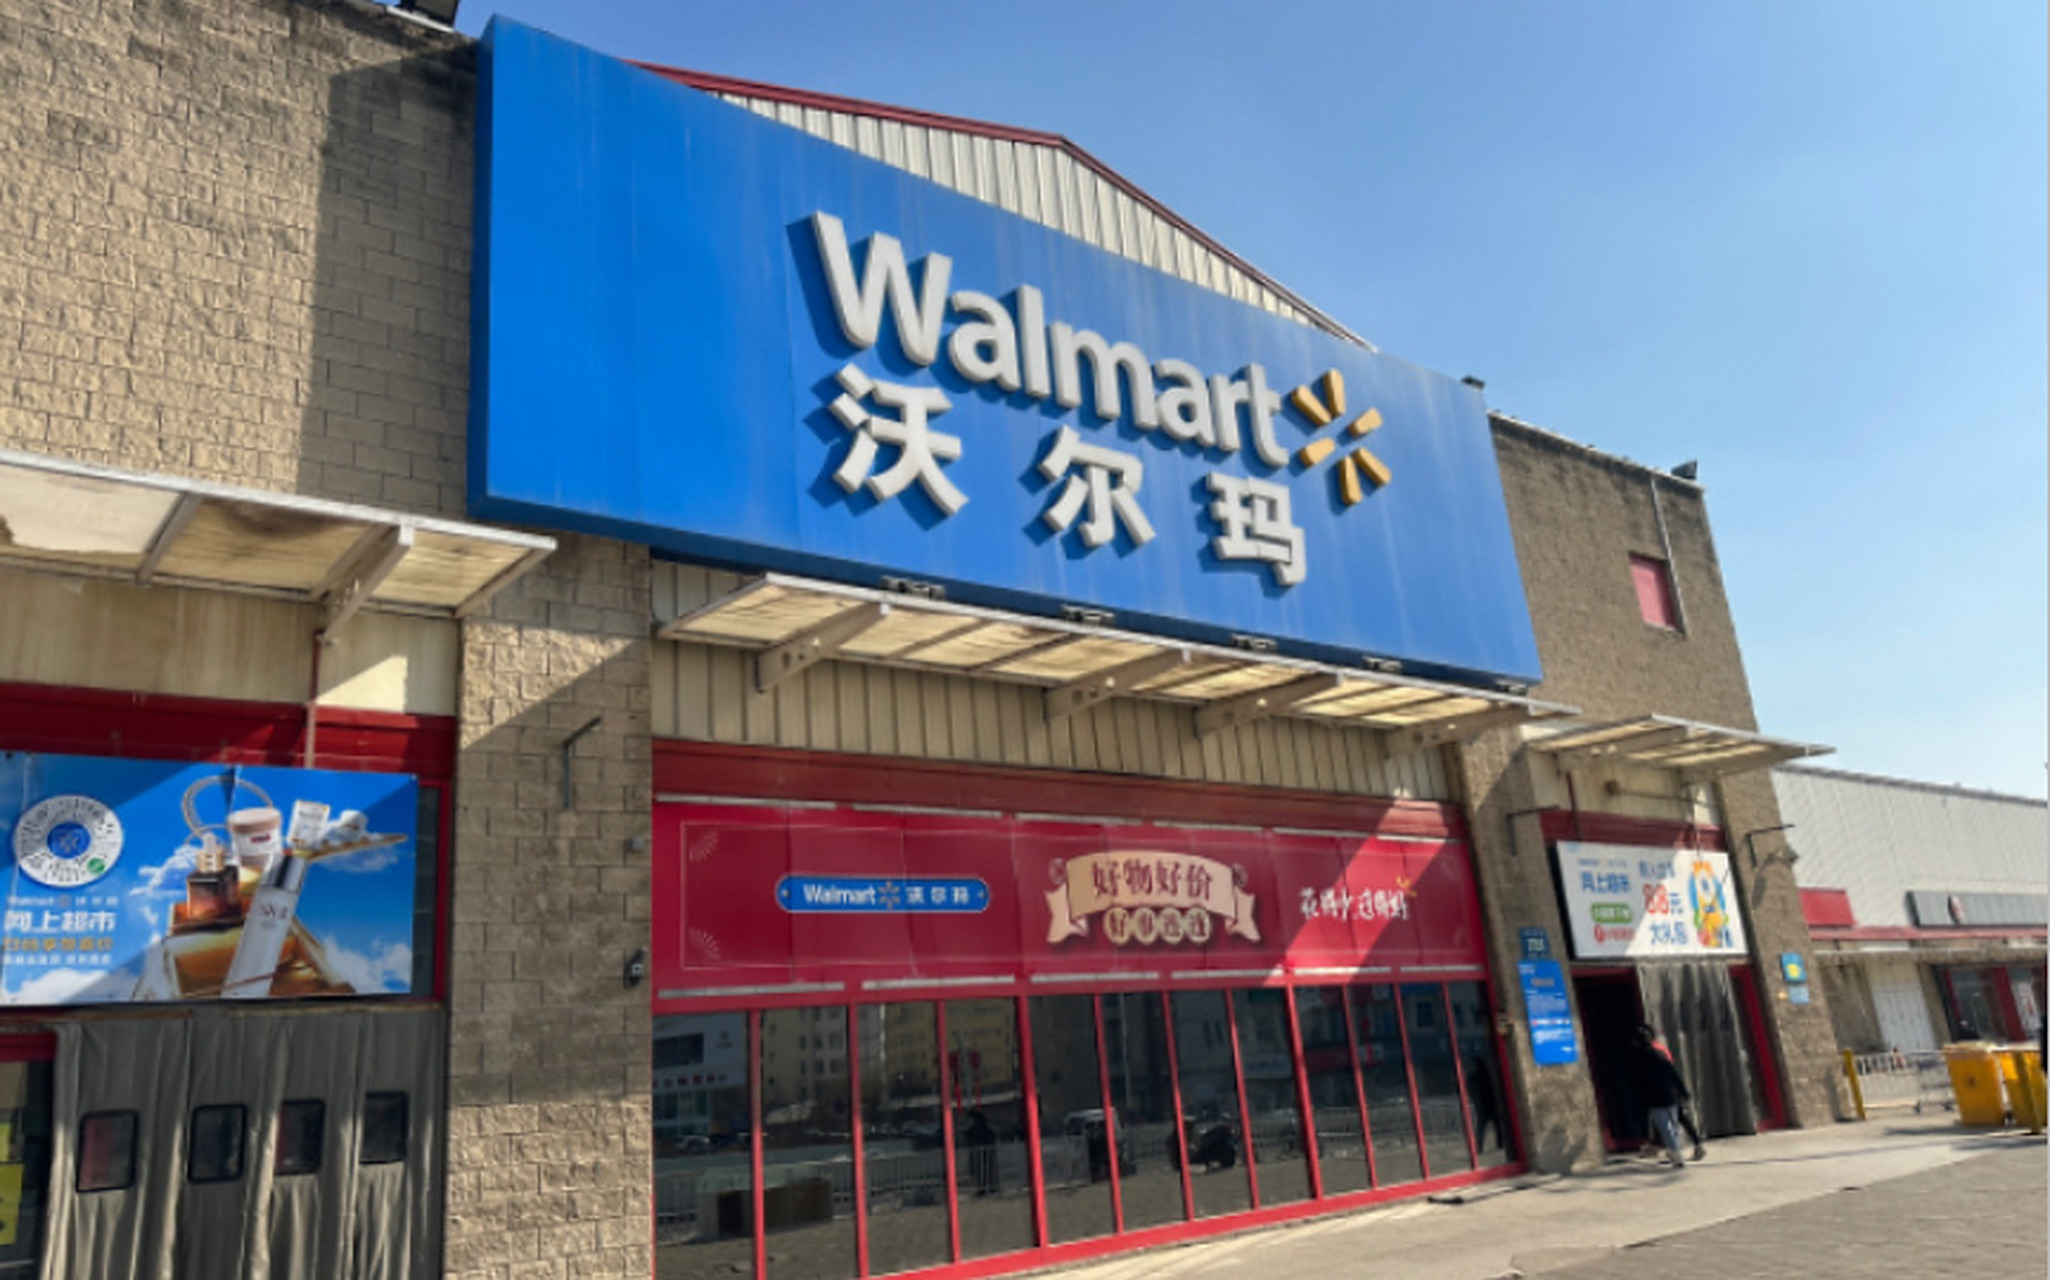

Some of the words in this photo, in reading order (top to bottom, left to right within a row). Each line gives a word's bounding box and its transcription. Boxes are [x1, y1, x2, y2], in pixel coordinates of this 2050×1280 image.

[813, 211, 1289, 467] Walmart
[830, 363, 1306, 587] 沃尔玛
[803, 884, 876, 905] Walmart
[906, 886, 969, 905] 沃尔玛
[1093, 859, 1212, 901] 好物好价
[4, 910, 116, 933] 网上超市
